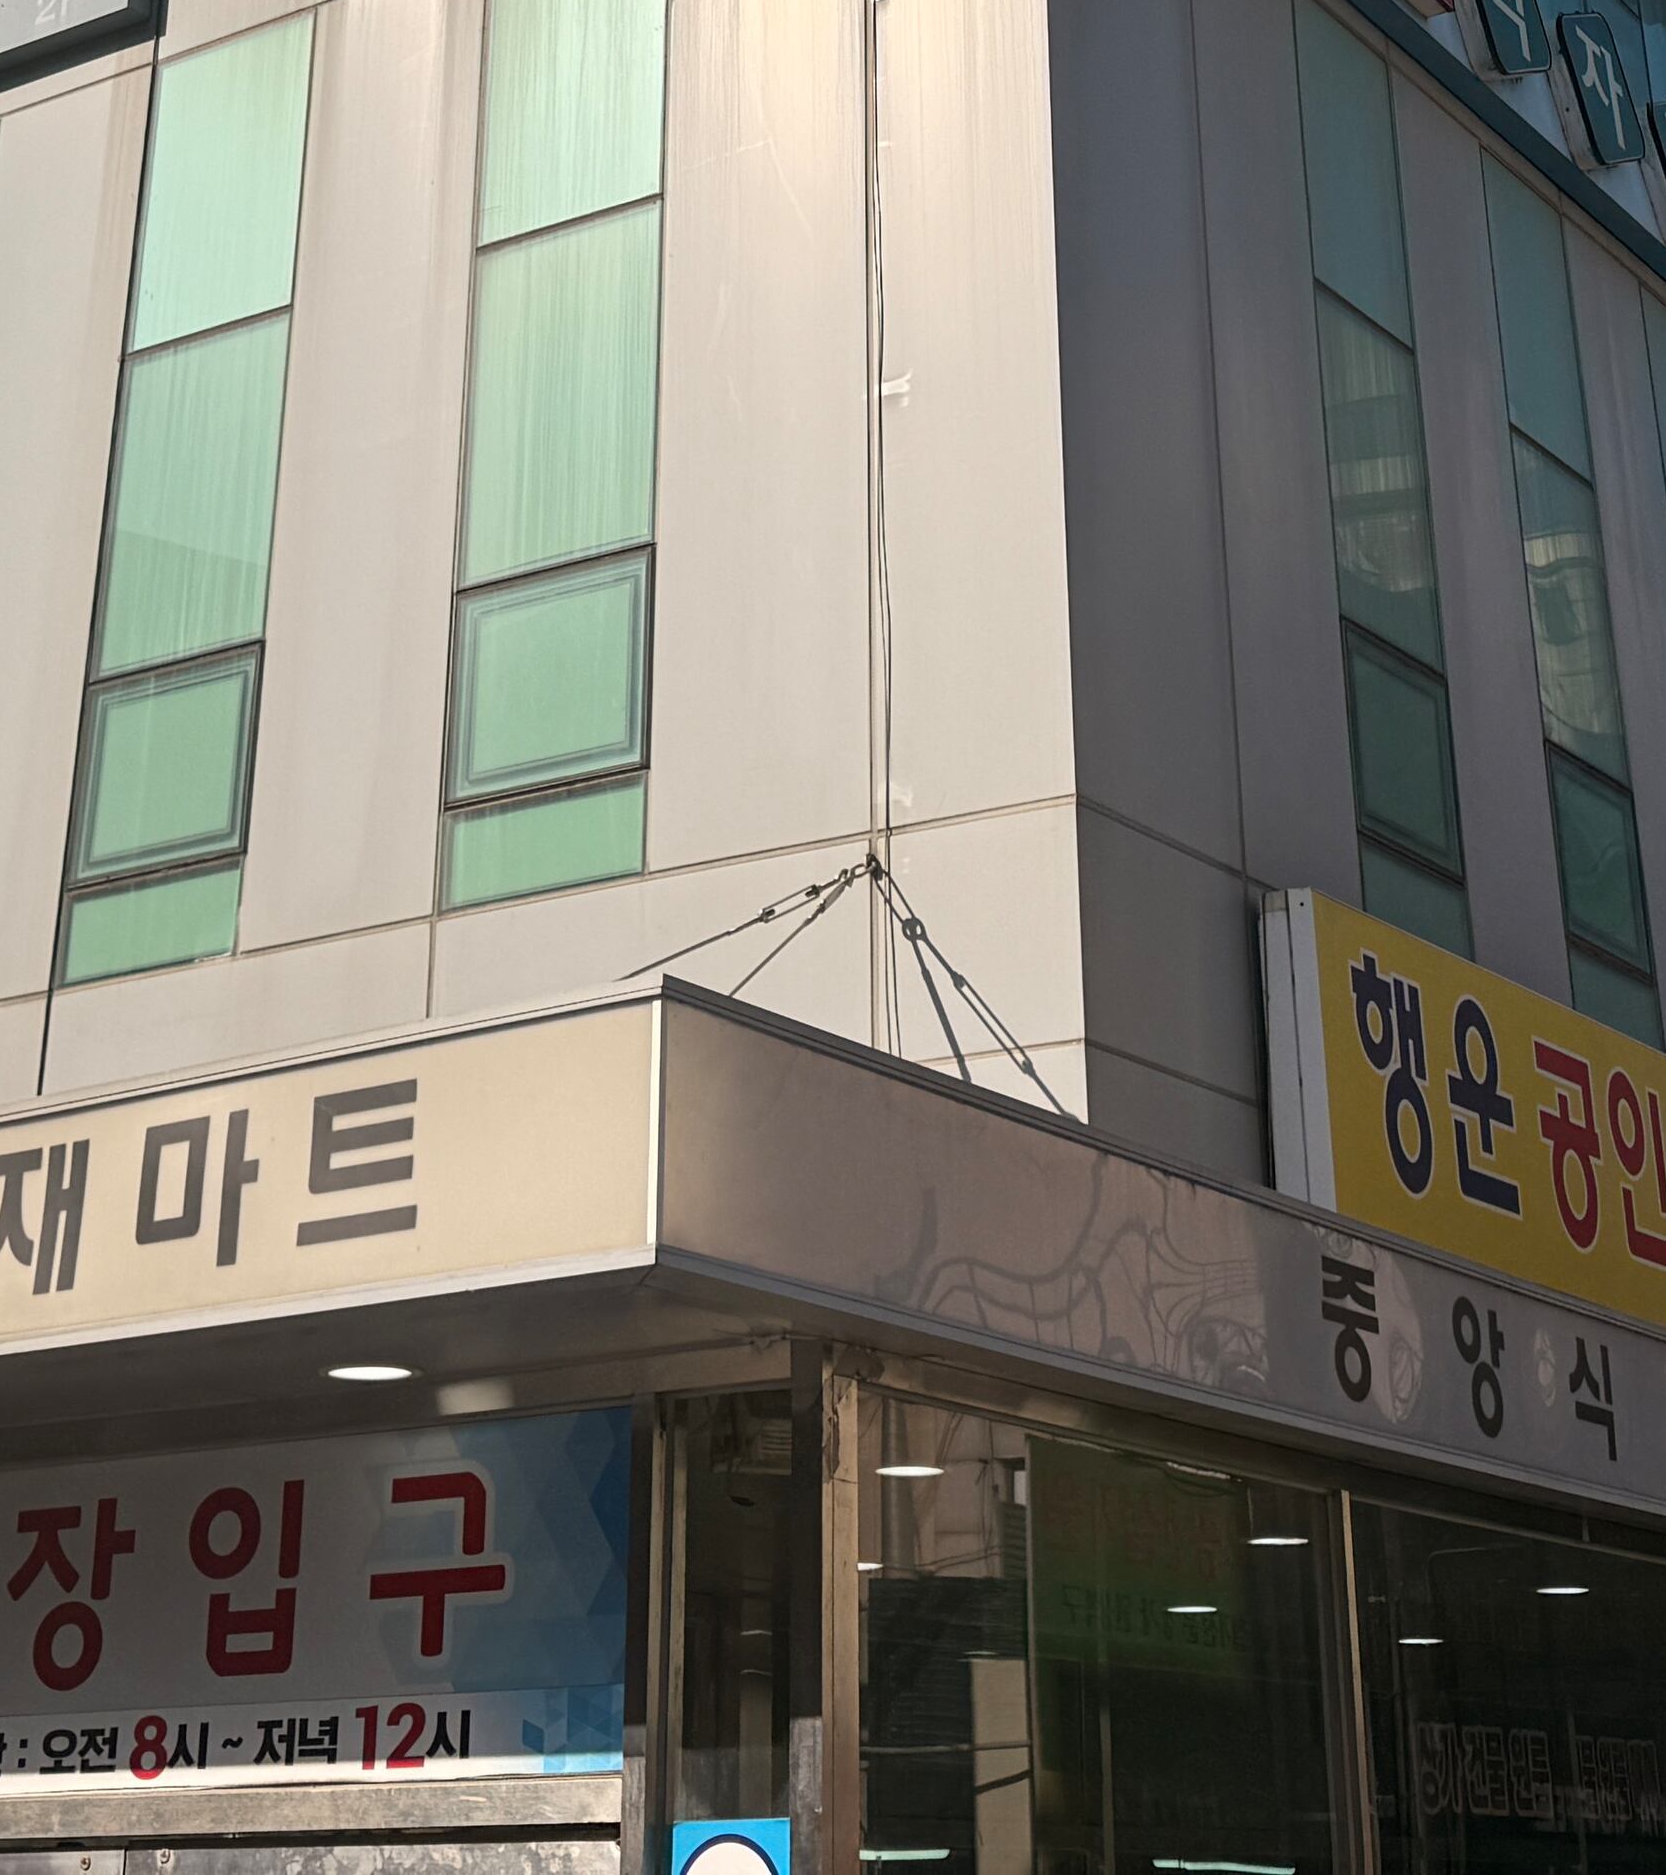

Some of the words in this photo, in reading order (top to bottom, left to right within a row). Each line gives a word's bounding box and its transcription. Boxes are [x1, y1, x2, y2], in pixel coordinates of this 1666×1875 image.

[1349, 951, 1523, 1219] 행운
[39, 1727, 119, 1774] 오전
[128, 1714, 210, 1781] 8시
[254, 1715, 340, 1767] 저녁
[354, 1701, 473, 1772] 12시
